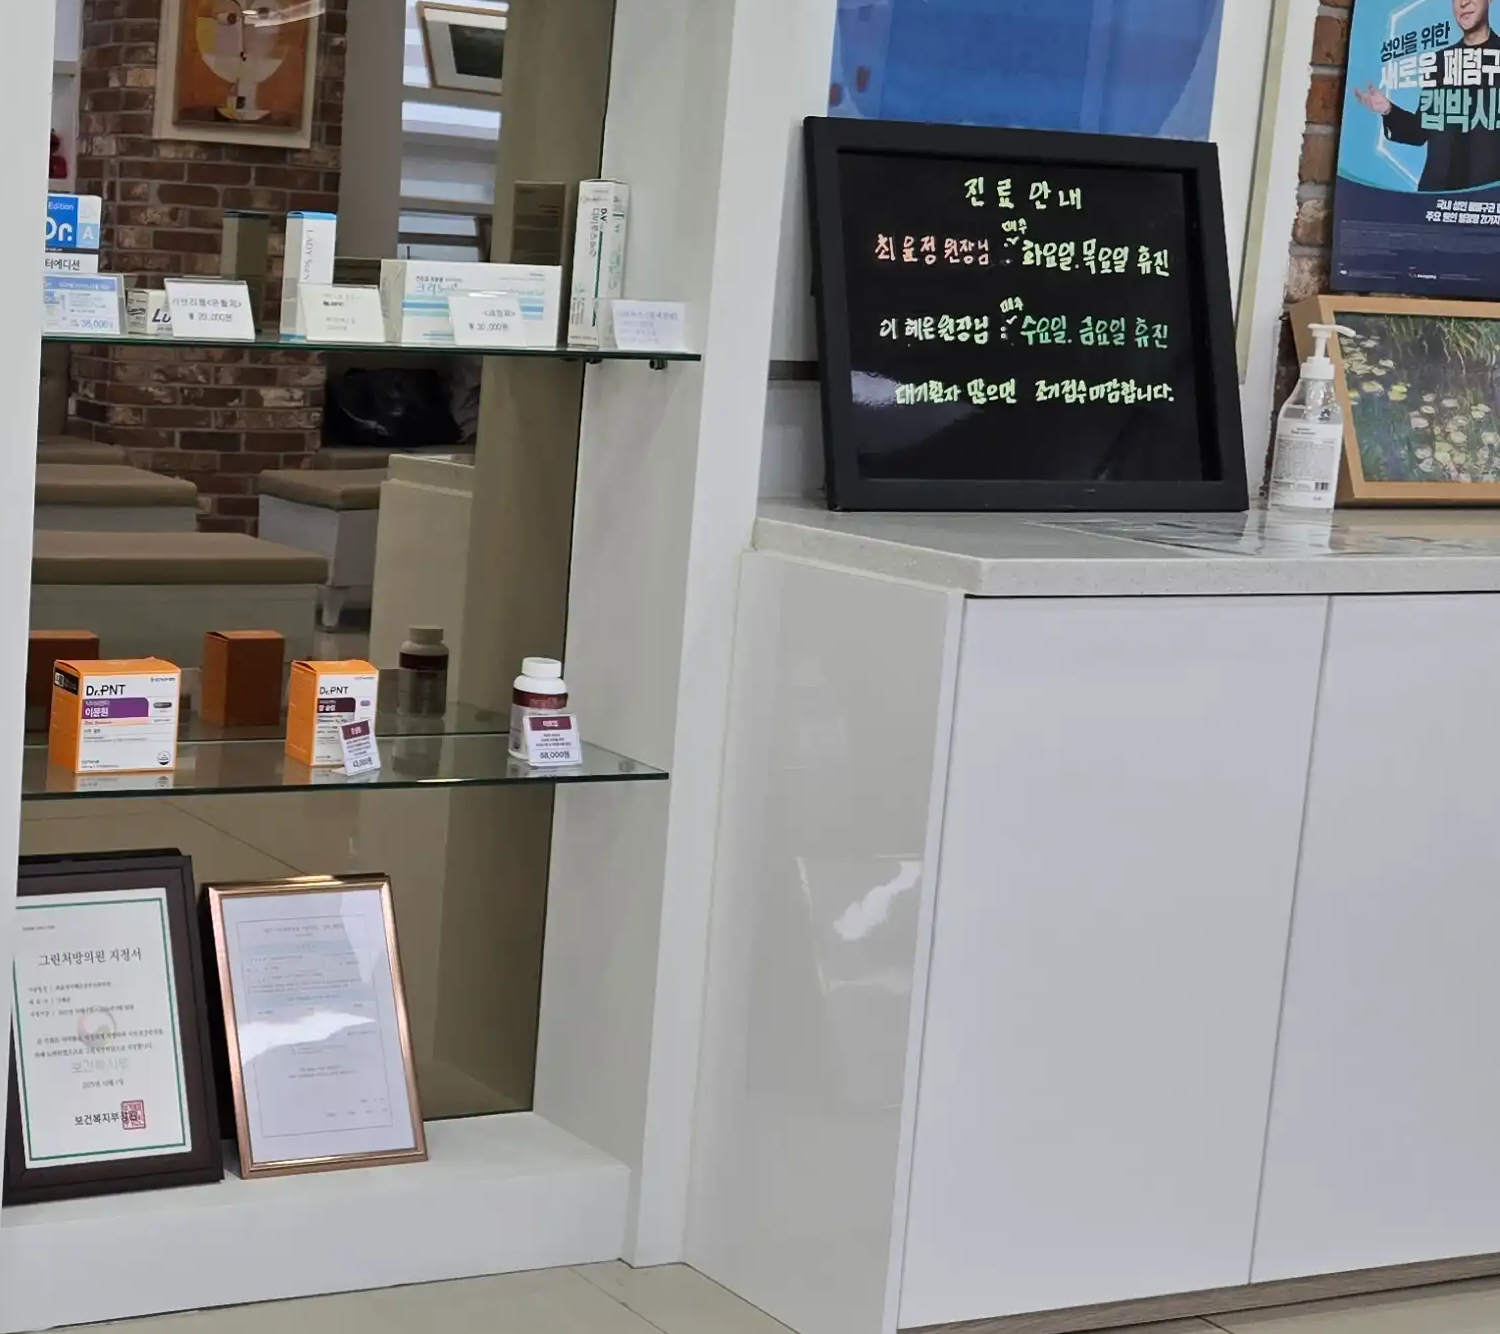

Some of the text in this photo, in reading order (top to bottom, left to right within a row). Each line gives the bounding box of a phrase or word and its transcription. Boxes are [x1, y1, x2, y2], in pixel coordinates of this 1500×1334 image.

[1380, 21, 1451, 63] 성인을 위한
[1381, 52, 1438, 91] 새로운
[944, 238, 989, 265] 원장님
[1136, 245, 1170, 276] 휴진
[1078, 316, 1126, 347] 금요일
[1134, 317, 1169, 349] 휴진
[895, 379, 962, 404] 대기환자
[86, 684, 127, 696] Dr.PNT
[109, 946, 142, 962] 지정서
